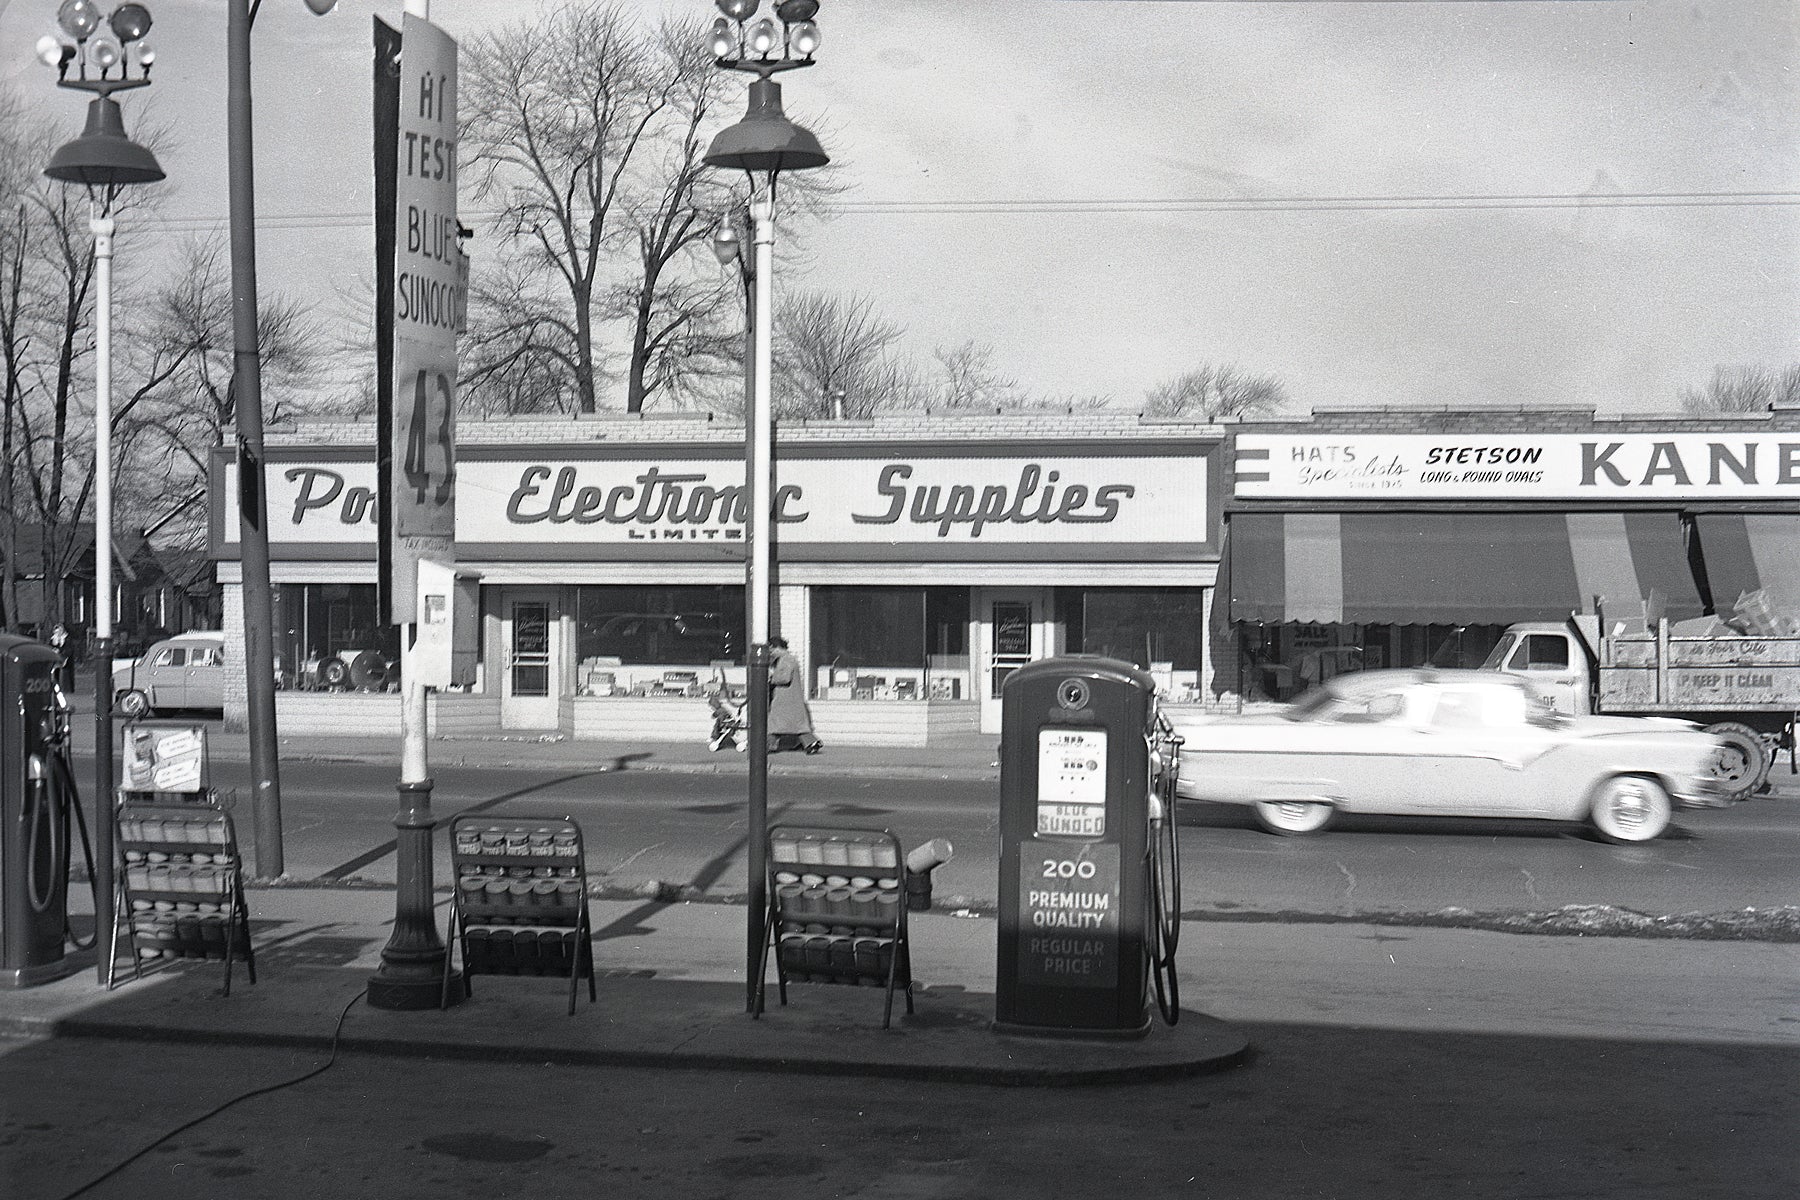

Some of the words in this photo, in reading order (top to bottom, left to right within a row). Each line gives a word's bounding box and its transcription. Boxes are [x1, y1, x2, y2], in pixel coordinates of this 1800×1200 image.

[405, 131, 455, 183] TEST
[408, 205, 452, 265] BLUE
[398, 272, 456, 330] SUNOCO
[403, 369, 456, 506] 43
[1291, 446, 1356, 462] HATS
[1425, 447, 1542, 464] STETSON
[1420, 471, 1452, 483] LONG
[1461, 471, 1503, 483] ROUND
[1505, 471, 1544, 483] OVALS
[285, 467, 377, 525] Po
[506, 465, 809, 525] Electronc
[851, 463, 1135, 537] Supplies
[628, 529, 742, 540] LIMITE
[1725, 675, 1734, 687] IT
[1056, 806, 1088, 815] BLUE
[1040, 815, 1104, 832] SUNOCO
[1043, 860, 1096, 878] 200
[1029, 891, 1108, 909] PREMIUM
[1033, 911, 1104, 928] QUALITY
[1031, 940, 1104, 955] REGULAR
[1045, 958, 1091, 974] PRICE
